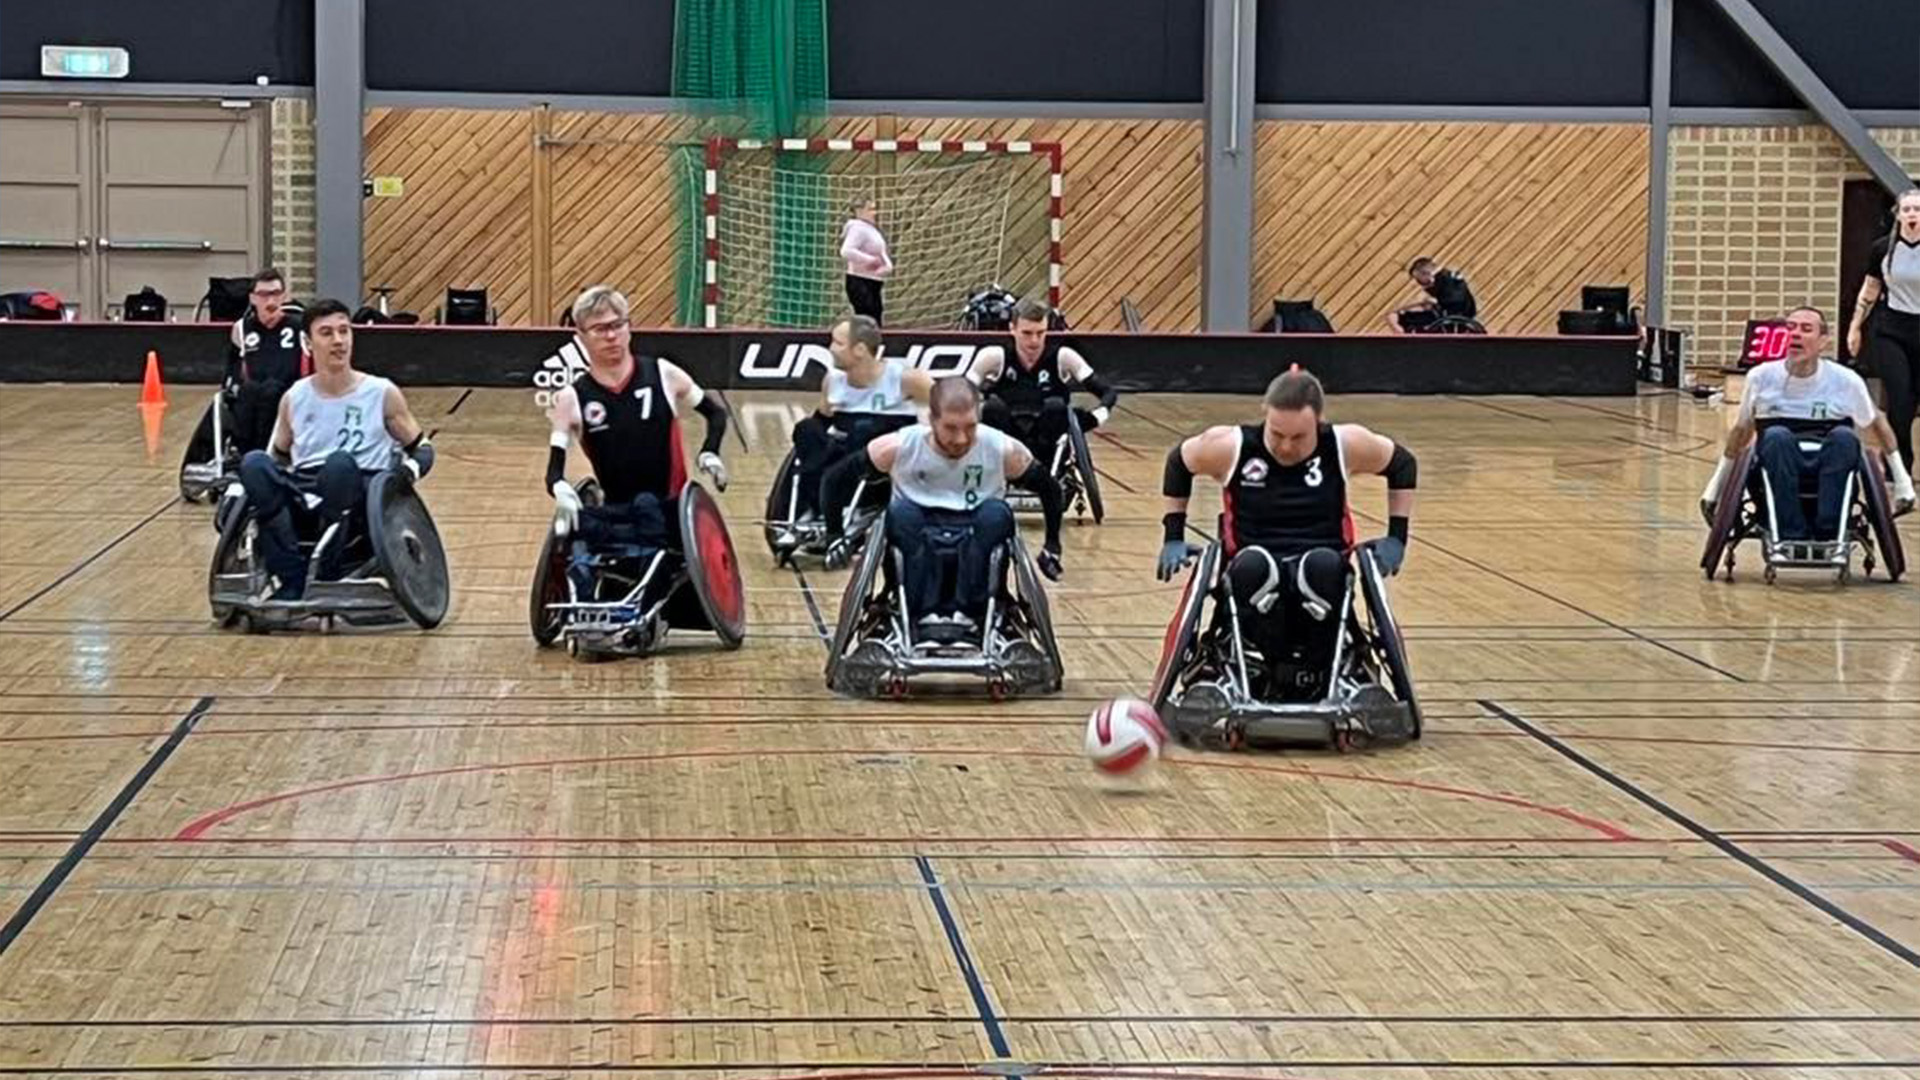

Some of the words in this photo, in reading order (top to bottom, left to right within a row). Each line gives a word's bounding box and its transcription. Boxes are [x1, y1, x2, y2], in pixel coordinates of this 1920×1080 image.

[280, 327, 294, 348] 2
[1748, 326, 1788, 358] 30
[633, 386, 653, 420] 7
[337, 427, 364, 451] 22
[1304, 455, 1323, 487] 3
